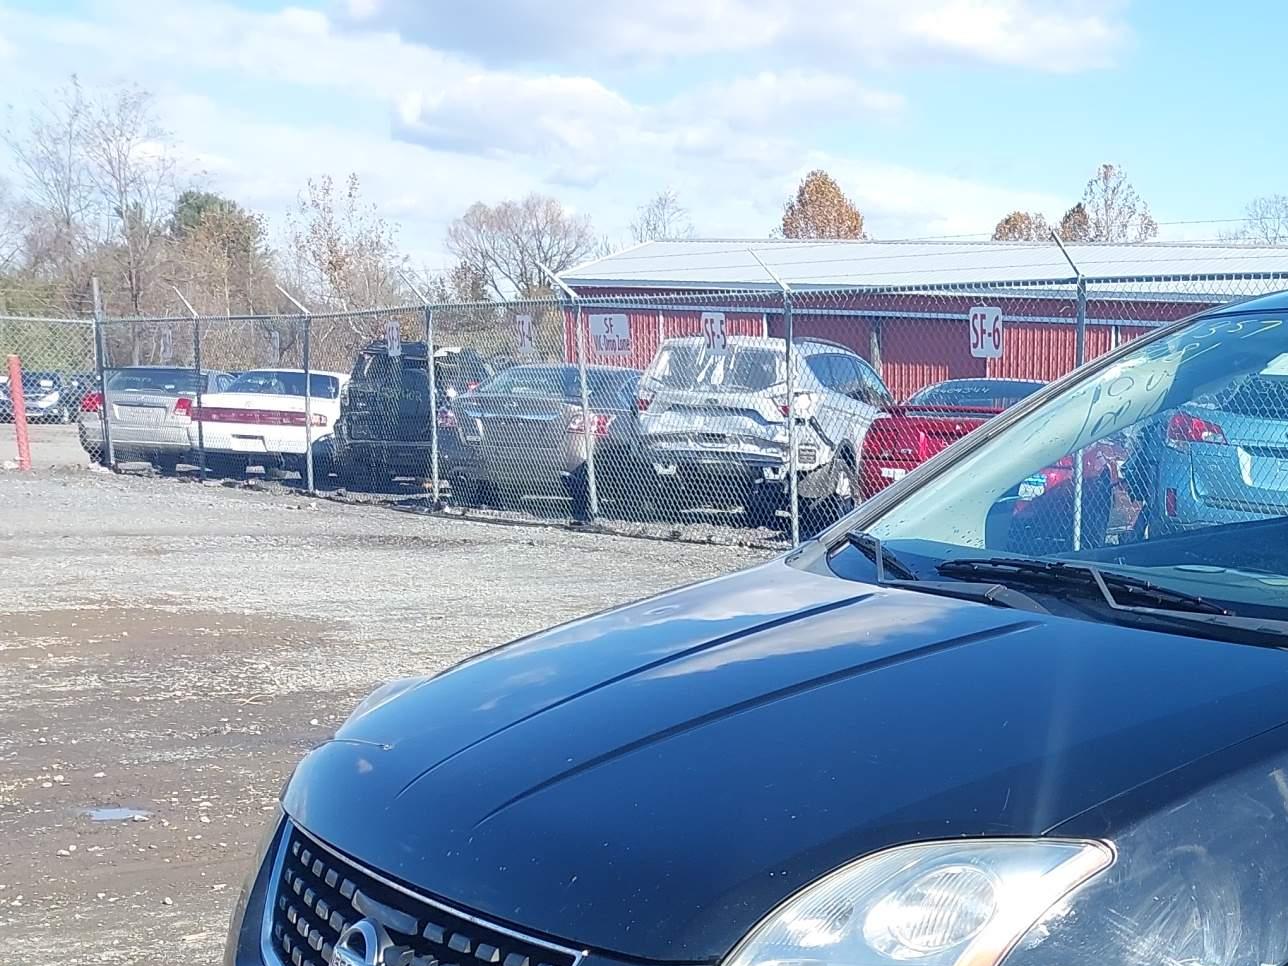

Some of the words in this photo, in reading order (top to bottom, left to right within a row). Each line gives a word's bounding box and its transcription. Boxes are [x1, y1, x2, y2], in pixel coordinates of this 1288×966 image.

[603, 317, 614, 334] SF
[704, 318, 727, 350] SF-5
[971, 313, 1001, 350] SF-6
